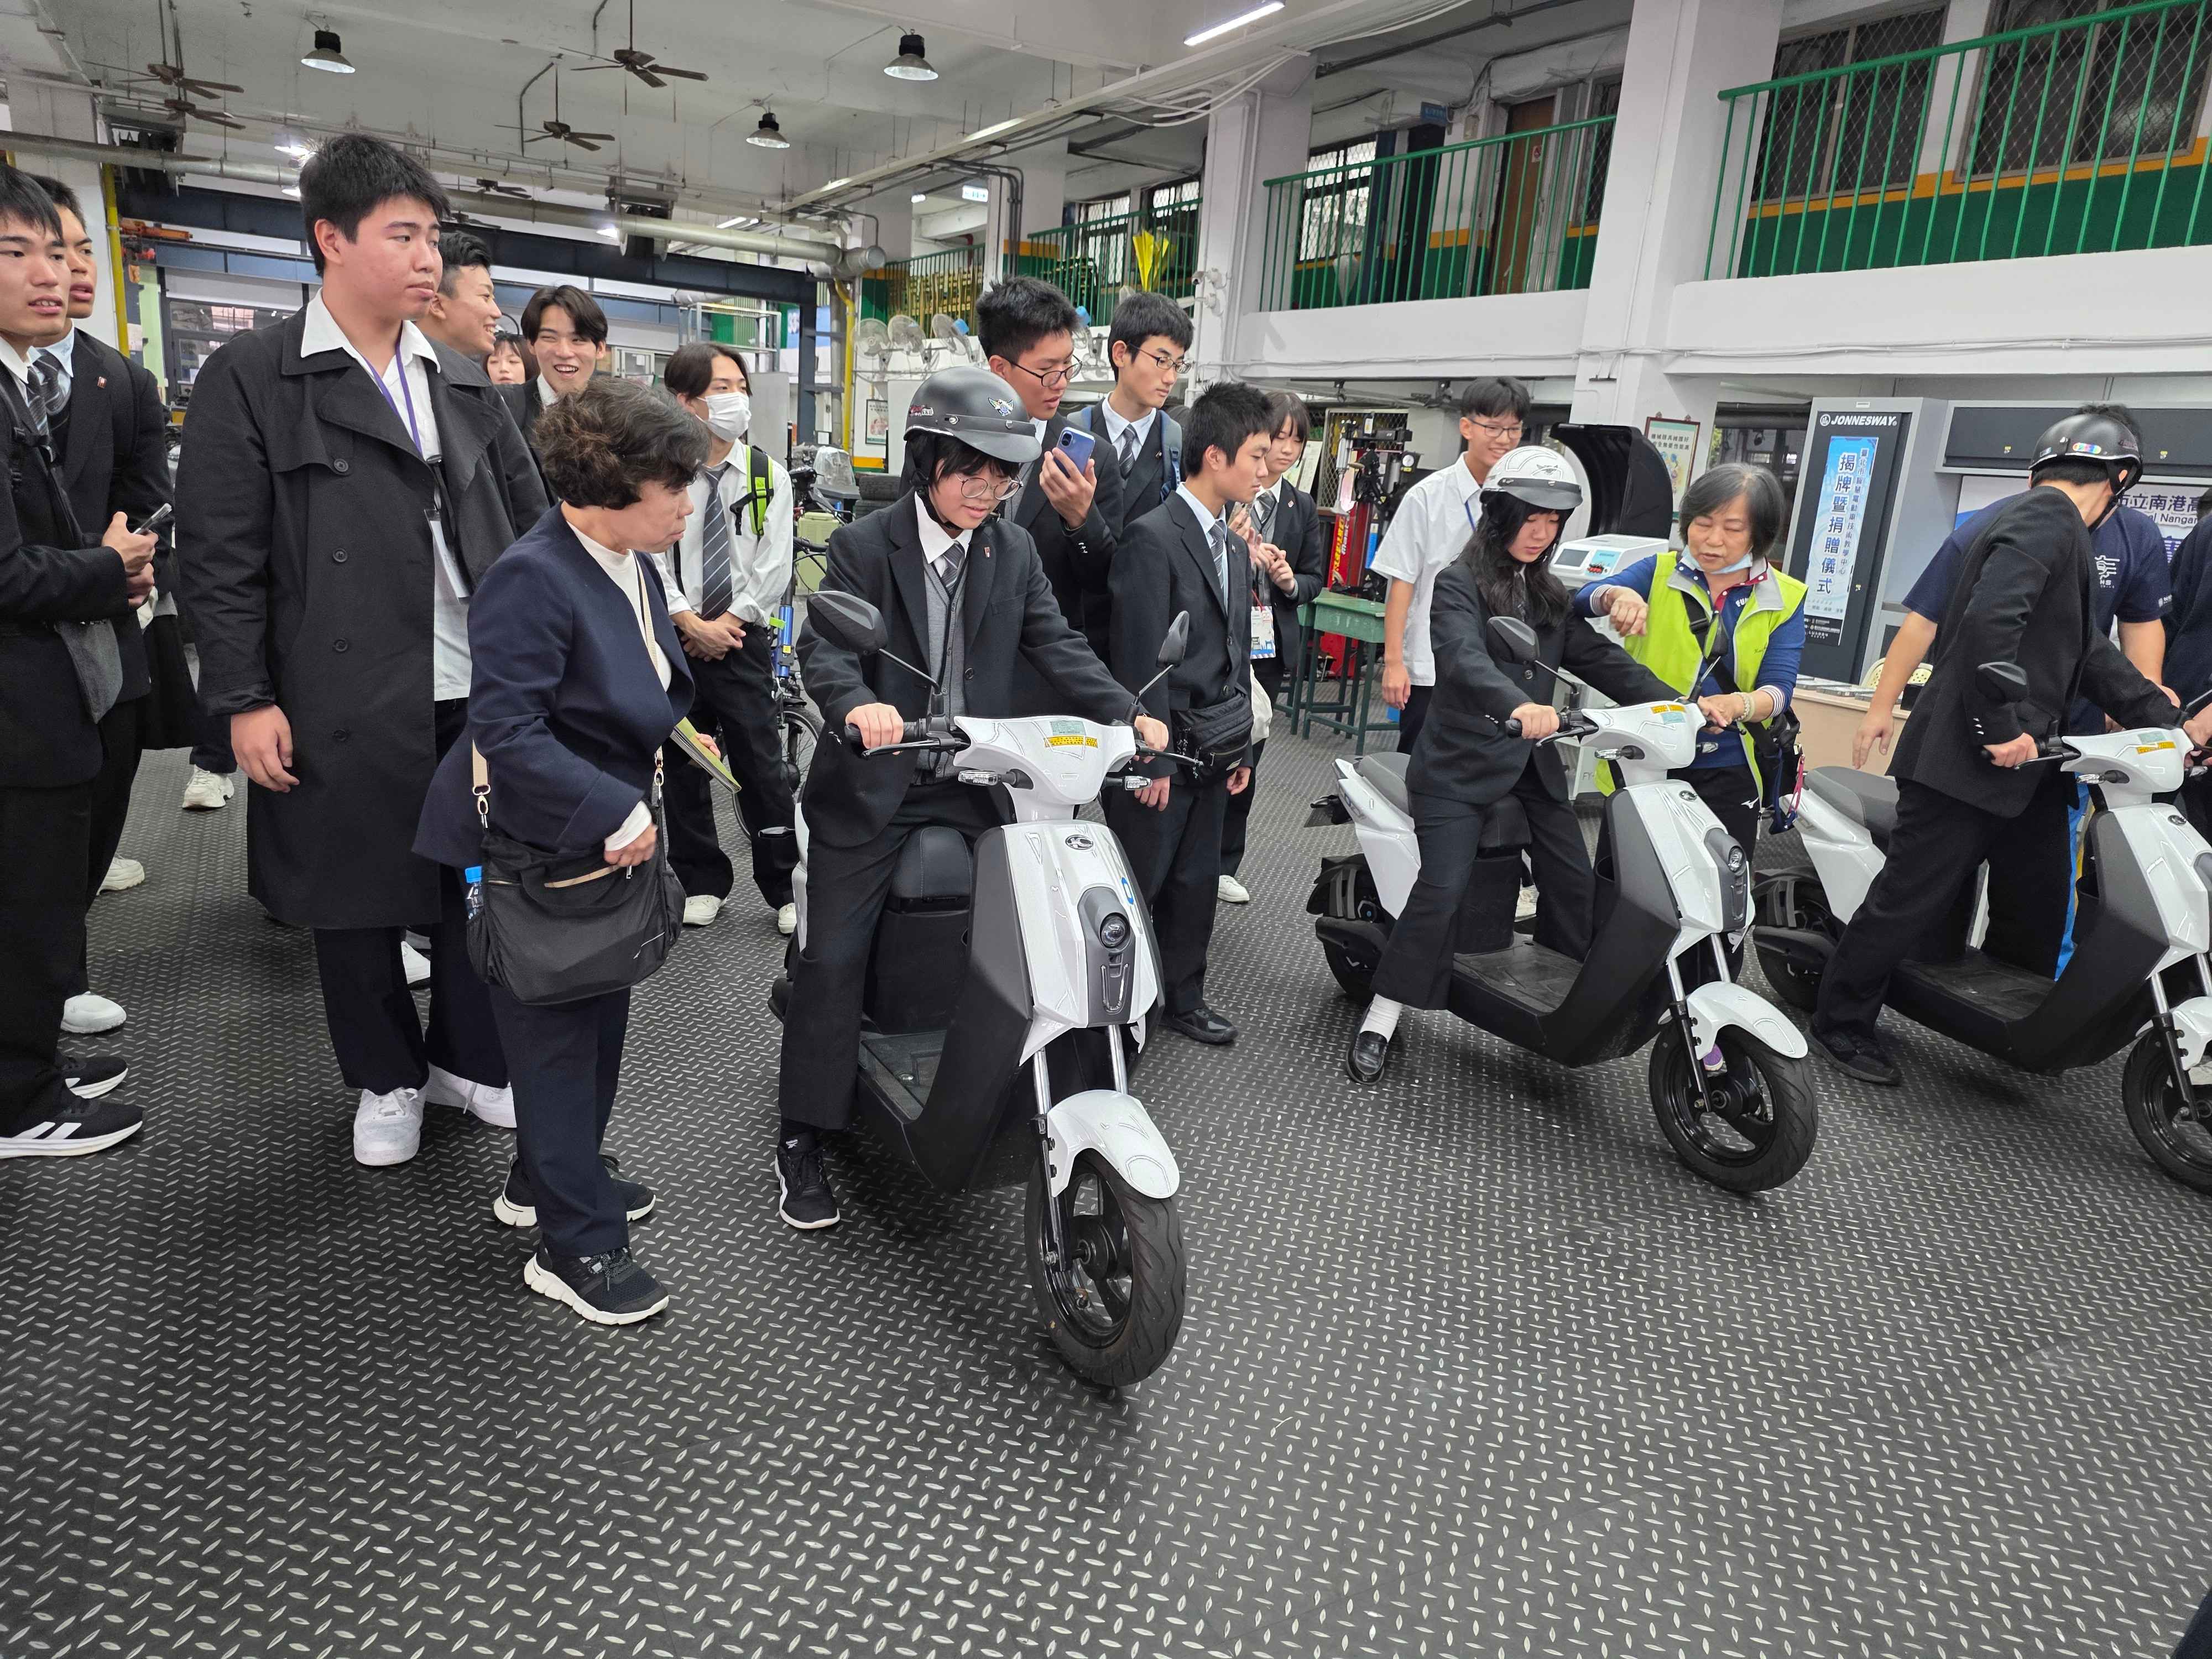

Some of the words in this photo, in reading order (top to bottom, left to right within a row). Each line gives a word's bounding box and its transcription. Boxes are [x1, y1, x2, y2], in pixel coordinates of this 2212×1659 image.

[1831, 415, 1897, 426] JONNESWAY
[1817, 453, 1856, 594] 揭牌暨捐贈儀式
